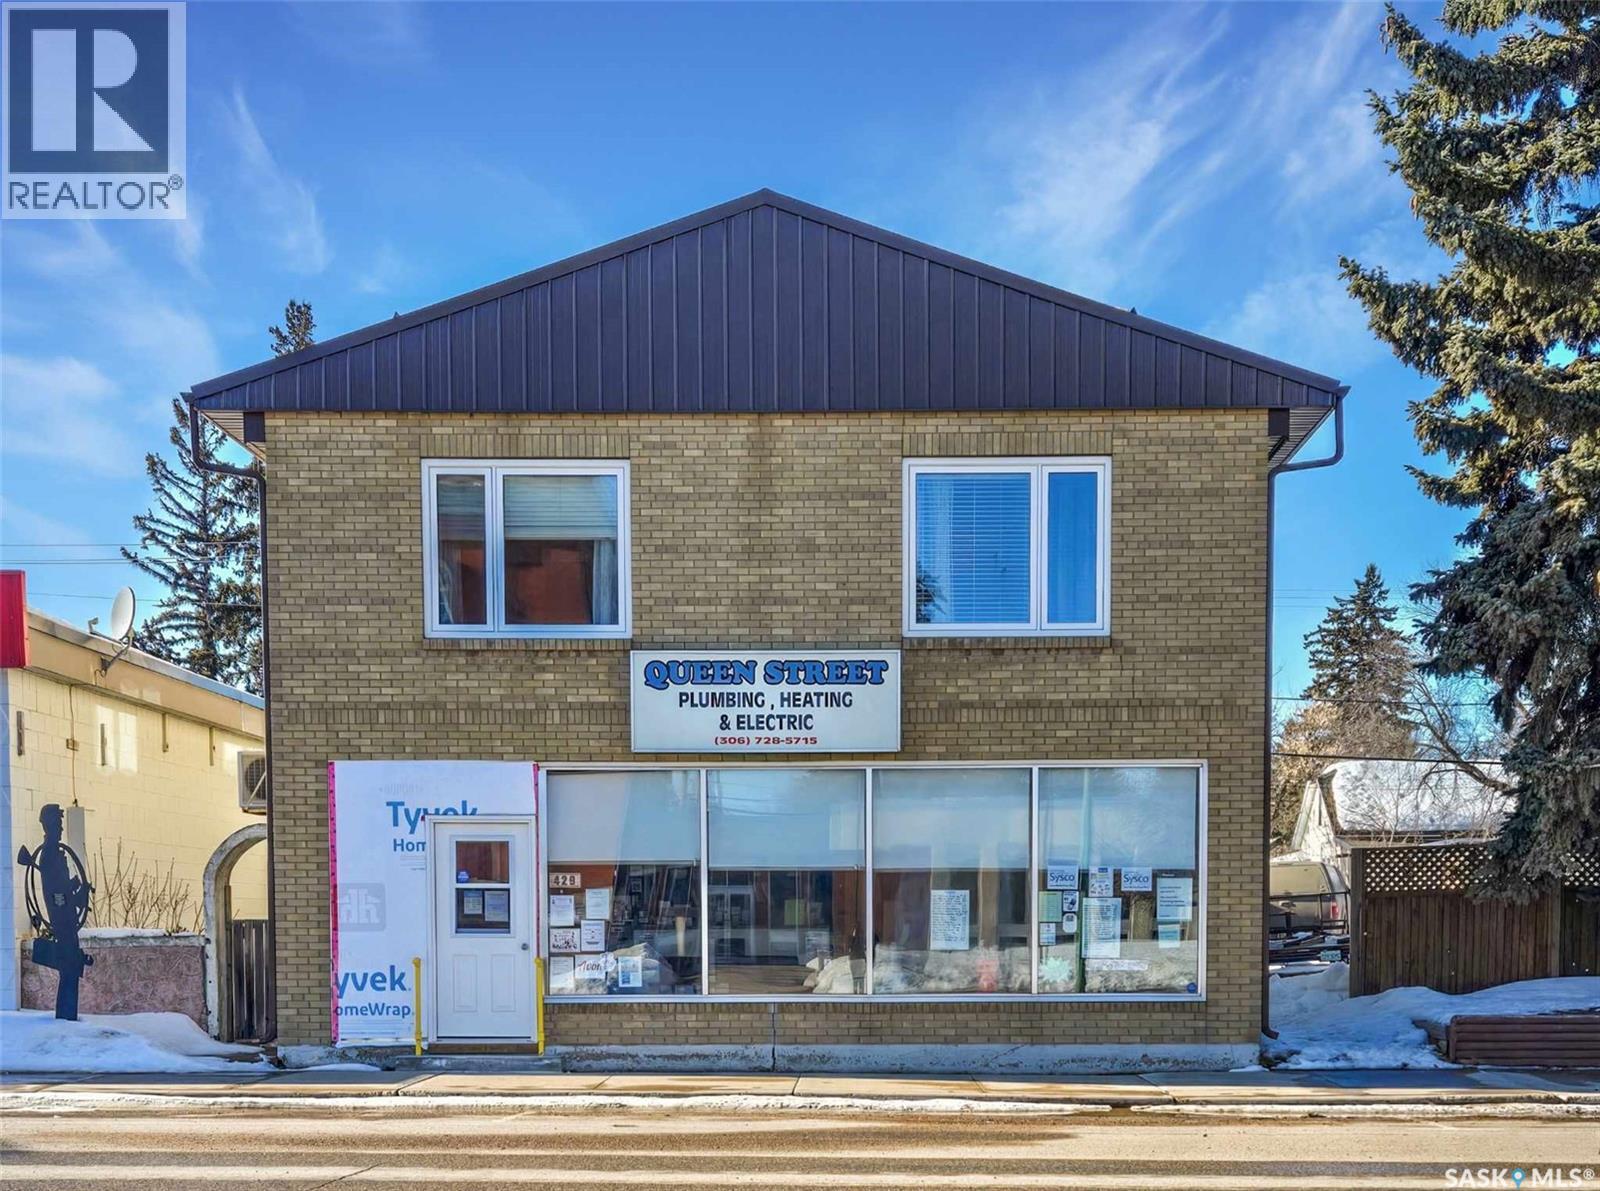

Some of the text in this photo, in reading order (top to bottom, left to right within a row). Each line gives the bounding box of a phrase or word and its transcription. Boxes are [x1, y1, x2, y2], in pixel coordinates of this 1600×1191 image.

[644, 660, 889, 690] QUEEN STREET
[780, 691, 853, 708] HEATING
[720, 714, 814, 731] & ELECTRIC
[715, 736, 818, 745] (306) 728-5715
[553, 875, 576, 886] 429
[1049, 872, 1076, 883] Sysco
[1123, 873, 1150, 885] Sysco
